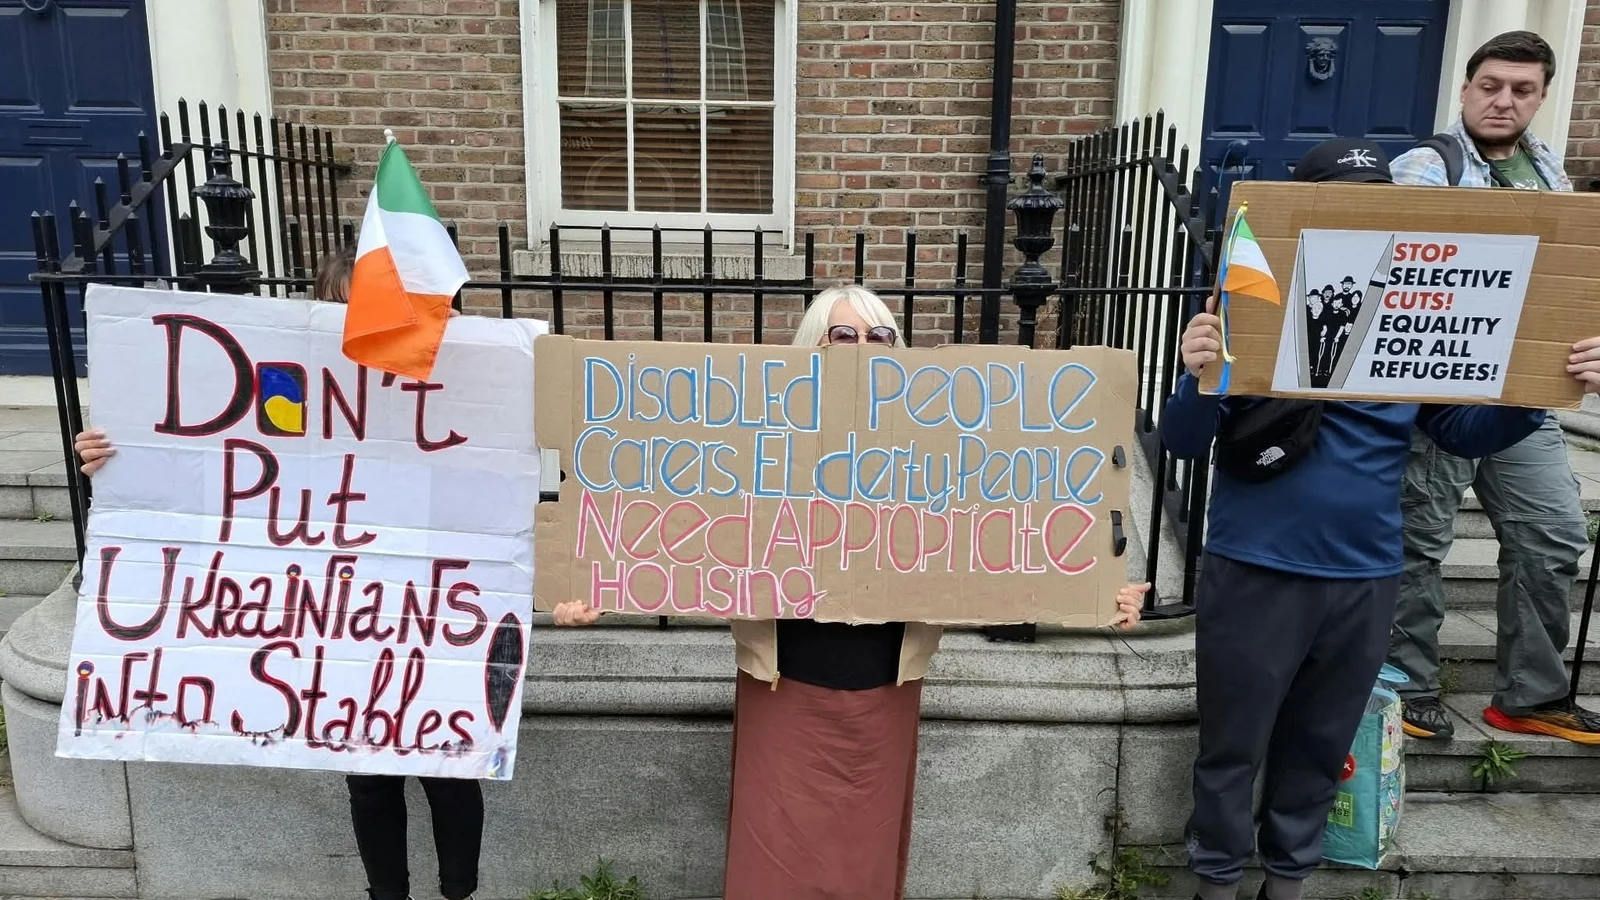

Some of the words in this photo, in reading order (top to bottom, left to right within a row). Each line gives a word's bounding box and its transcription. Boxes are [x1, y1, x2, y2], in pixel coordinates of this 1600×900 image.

[1393, 243, 1458, 263] STOP
[1387, 267, 1513, 289] SELECTIVE
[1384, 290, 1454, 311] CUTS!
[1378, 314, 1502, 335] EQUALITY
[1374, 337, 1424, 357] FOR
[1430, 339, 1472, 358] ALL
[1369, 360, 1500, 382] REFUGEES!
[219, 438, 378, 548] Put
[575, 488, 753, 569] Need
